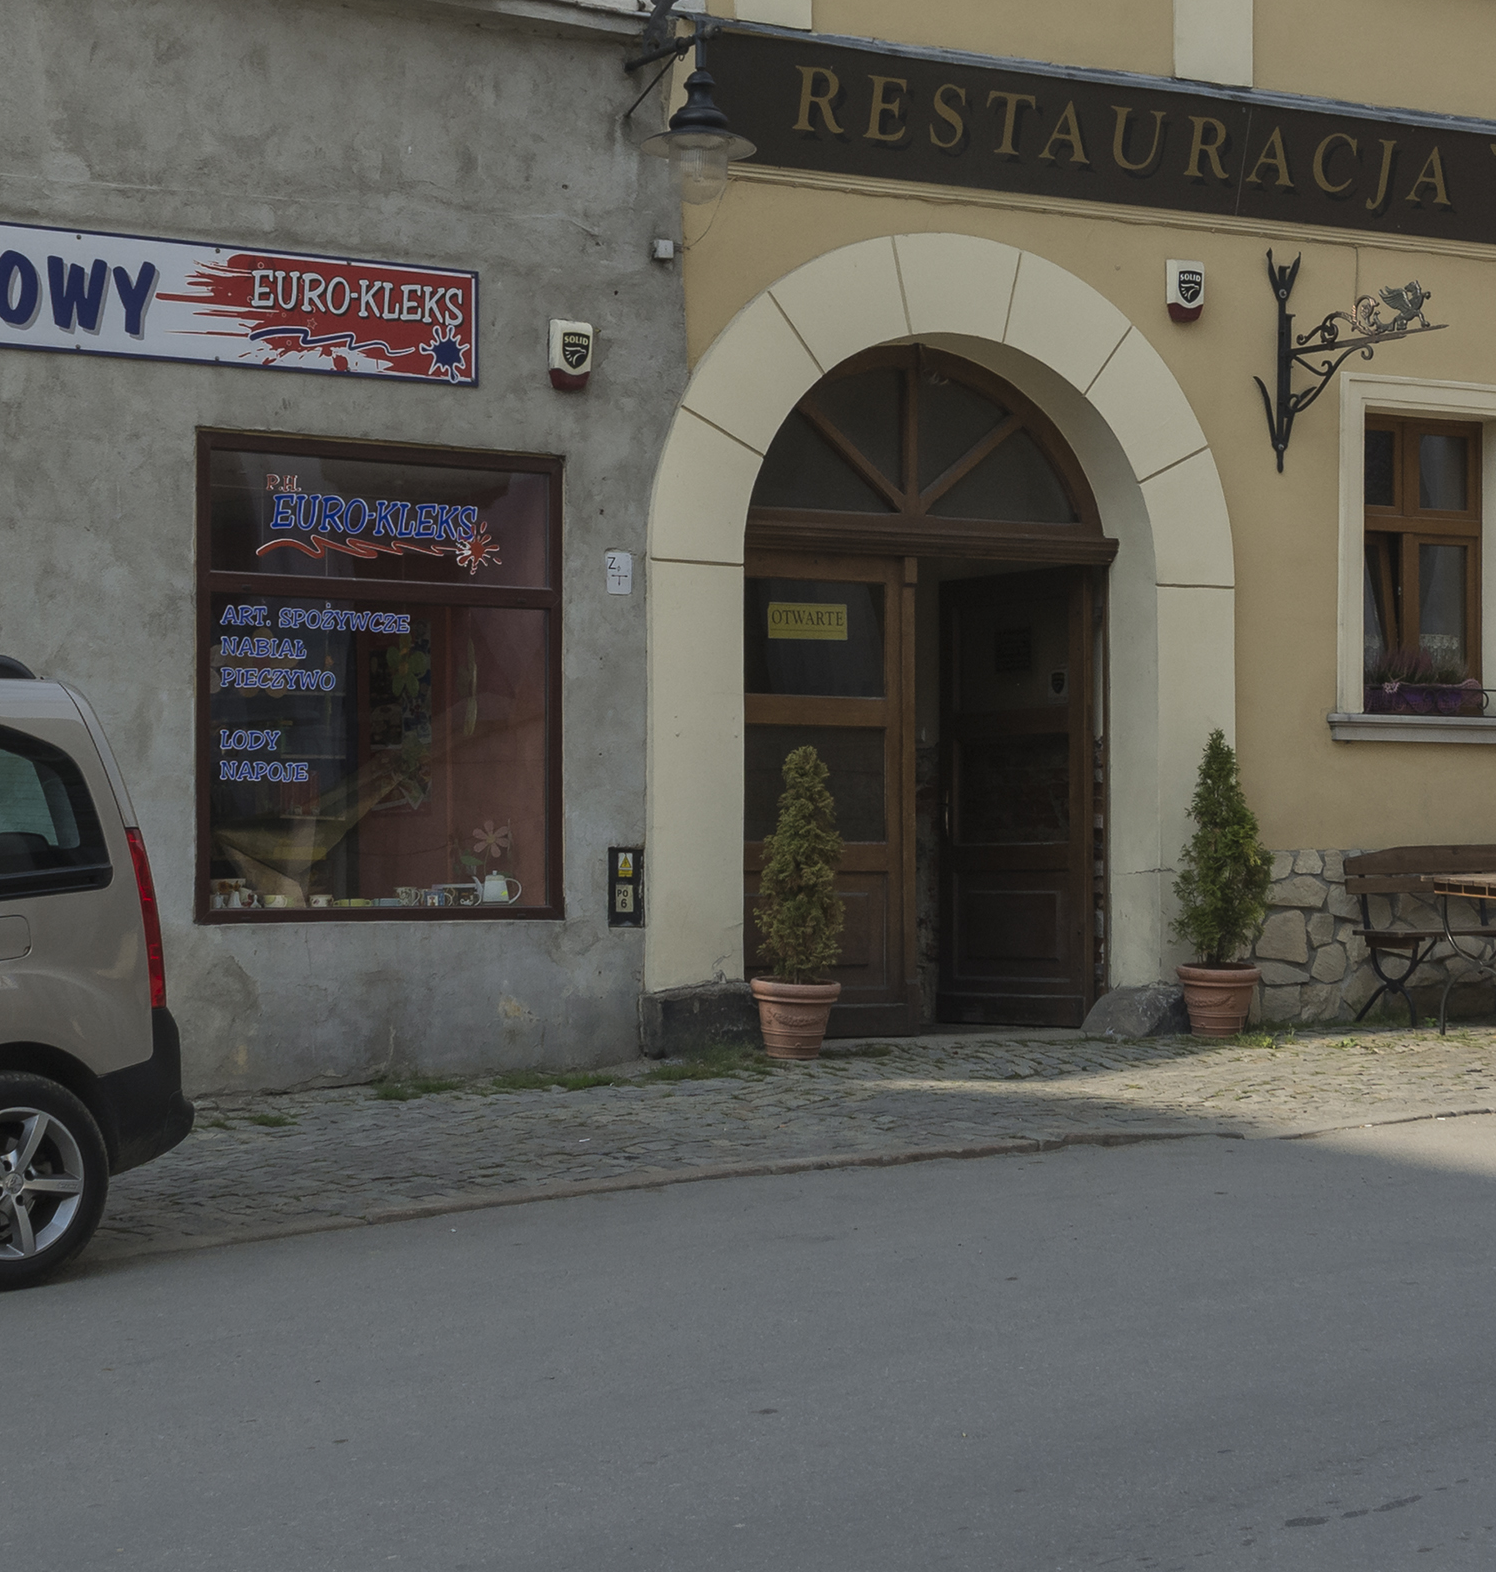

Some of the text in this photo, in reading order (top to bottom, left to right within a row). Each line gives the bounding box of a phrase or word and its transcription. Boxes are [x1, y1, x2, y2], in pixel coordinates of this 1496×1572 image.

[794, 65, 1452, 210] RESTAURACJA
[1180, 273, 1201, 282] SOLID
[251, 269, 464, 327] EURO-KLEKS
[564, 335, 589, 346] SOLID
[266, 473, 302, 493] P.H.
[270, 493, 478, 541] EURO-KLEKS
[220, 602, 411, 634] ART. SPOŻYWCZE
[771, 609, 844, 627] OTWARTE
[220, 636, 307, 659] NABIAŁ
[220, 667, 336, 691] PIECZYWO
[220, 729, 281, 751] LODY
[220, 761, 308, 782] NAPOJE
[617, 889, 629, 898] PO
[620, 898, 628, 909] 6
